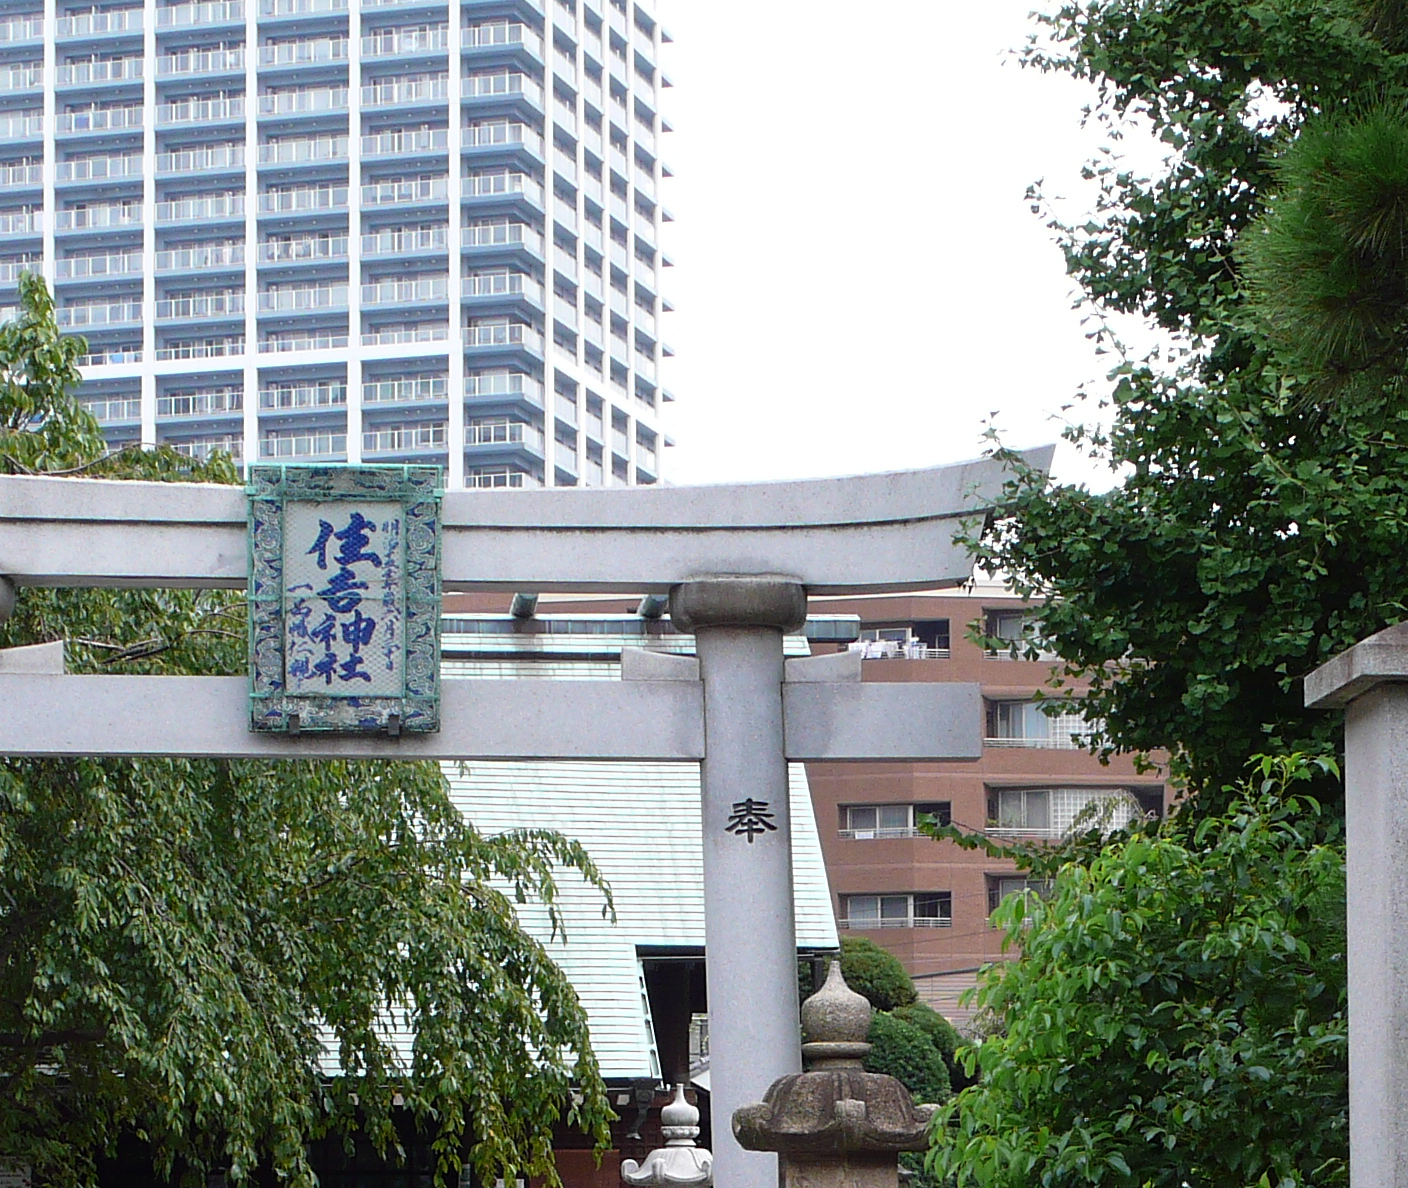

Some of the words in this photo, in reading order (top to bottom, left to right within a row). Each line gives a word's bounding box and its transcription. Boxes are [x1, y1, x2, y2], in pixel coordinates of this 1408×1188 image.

[305, 512, 383, 685] 住吉神社
[724, 797, 779, 844] 奉
